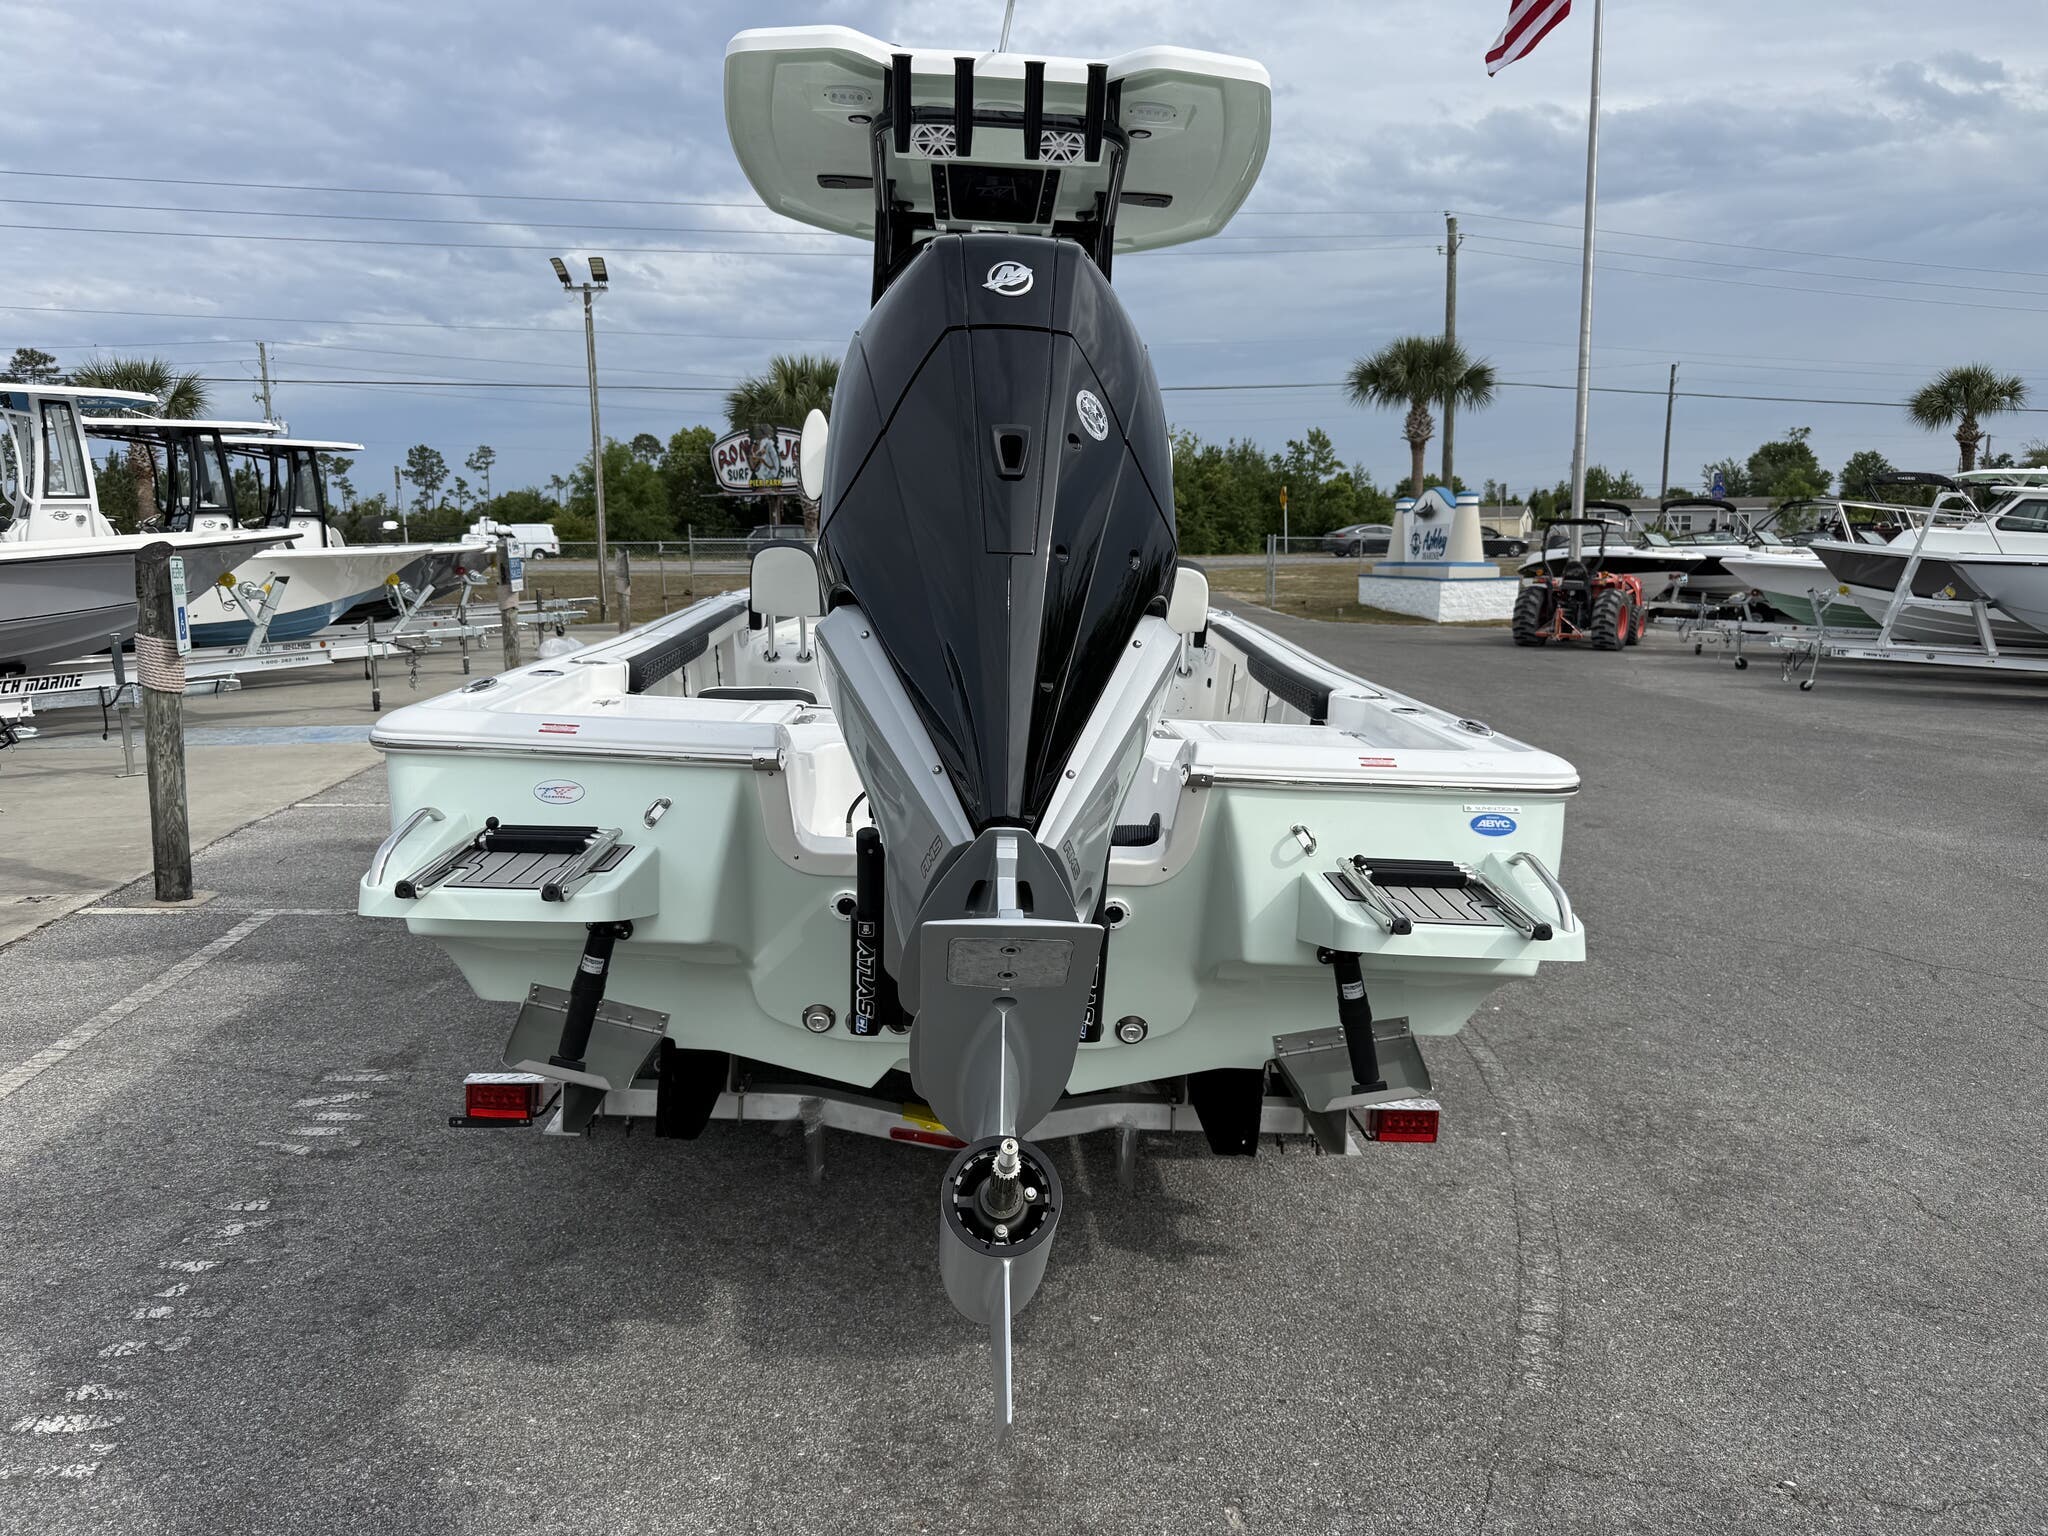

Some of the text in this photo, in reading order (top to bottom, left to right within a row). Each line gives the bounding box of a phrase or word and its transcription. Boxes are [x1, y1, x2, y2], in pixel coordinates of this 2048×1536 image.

[780, 439, 801, 462] JO
[727, 466, 798, 481] SURF SHO
[0, 674, 83, 693] CH MARINE
[1476, 819, 1511, 828] ABYC
[856, 939, 876, 1019] ATLAS
